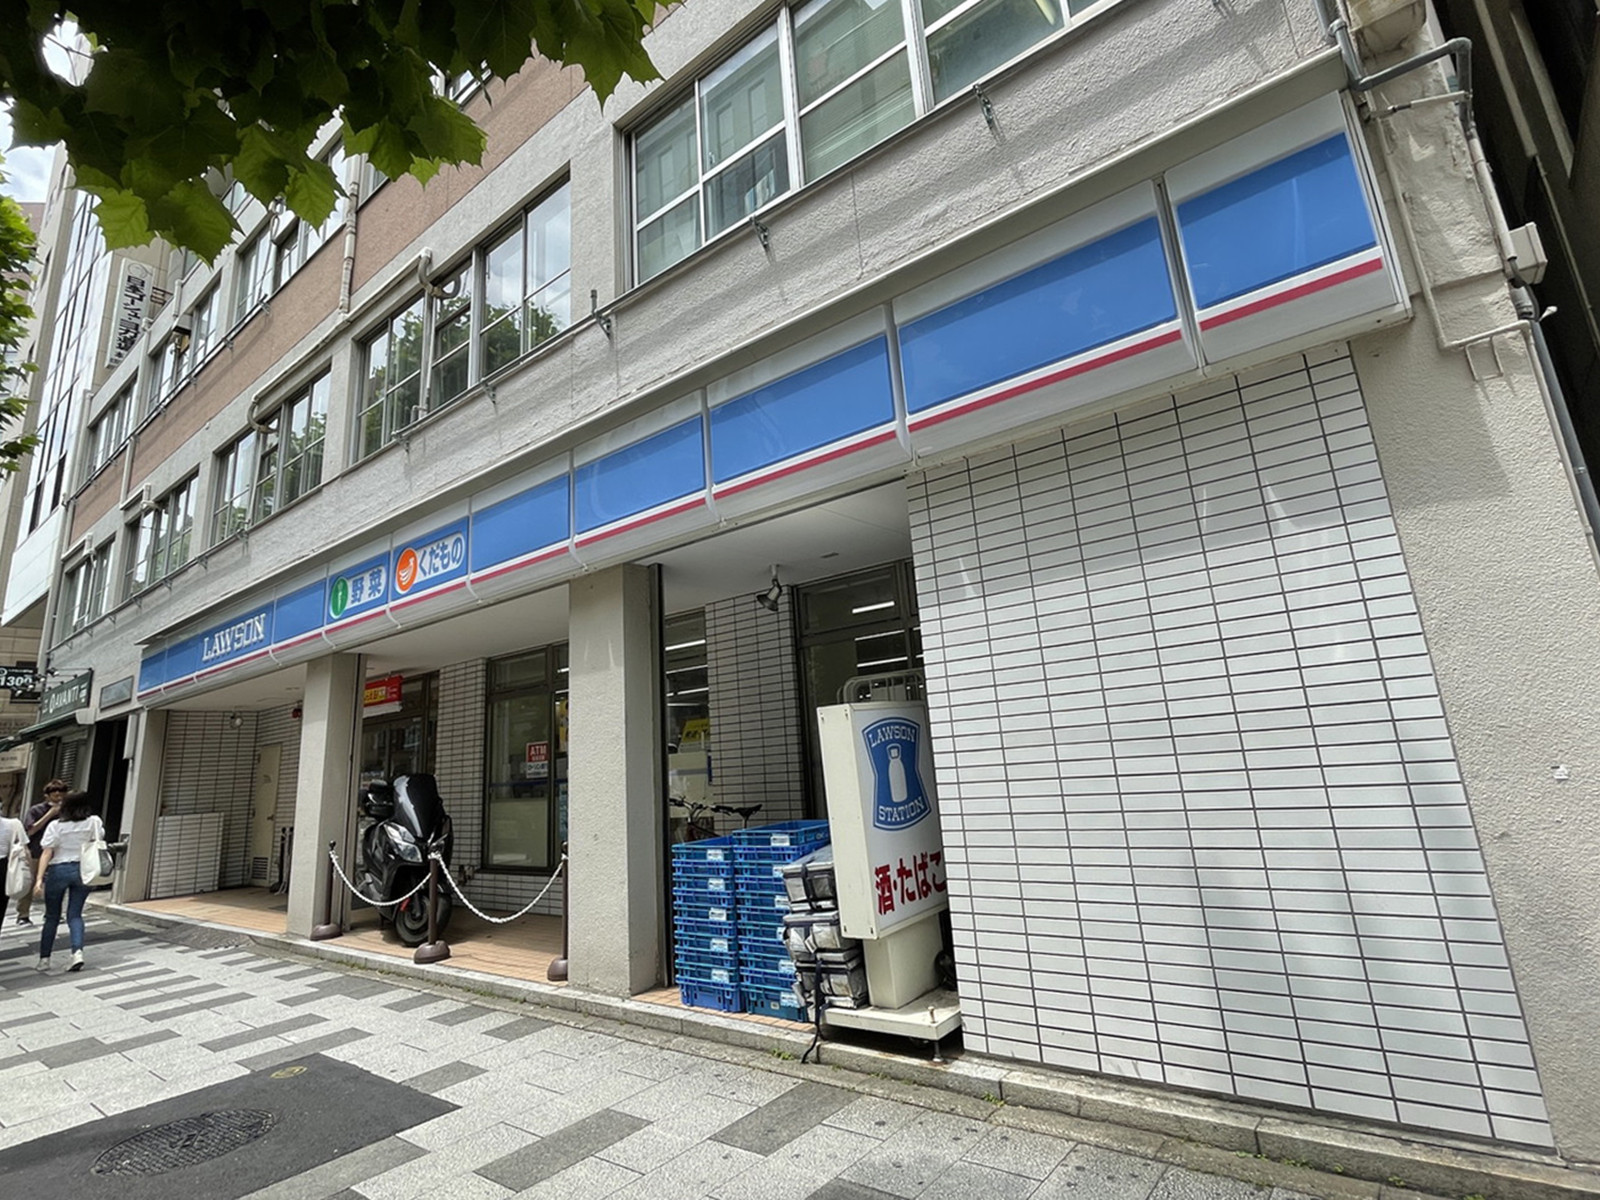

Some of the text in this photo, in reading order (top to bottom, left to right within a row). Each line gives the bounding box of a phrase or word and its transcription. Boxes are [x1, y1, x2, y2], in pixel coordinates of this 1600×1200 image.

[418, 536, 465, 578] くだもの
[351, 568, 383, 605] 野菜
[202, 612, 266, 661] LAWSON
[530, 745, 547, 756] ATM
[869, 725, 916, 749] LAWSON
[878, 796, 924, 822] STATION
[875, 851, 947, 915] 酒・たばこ
